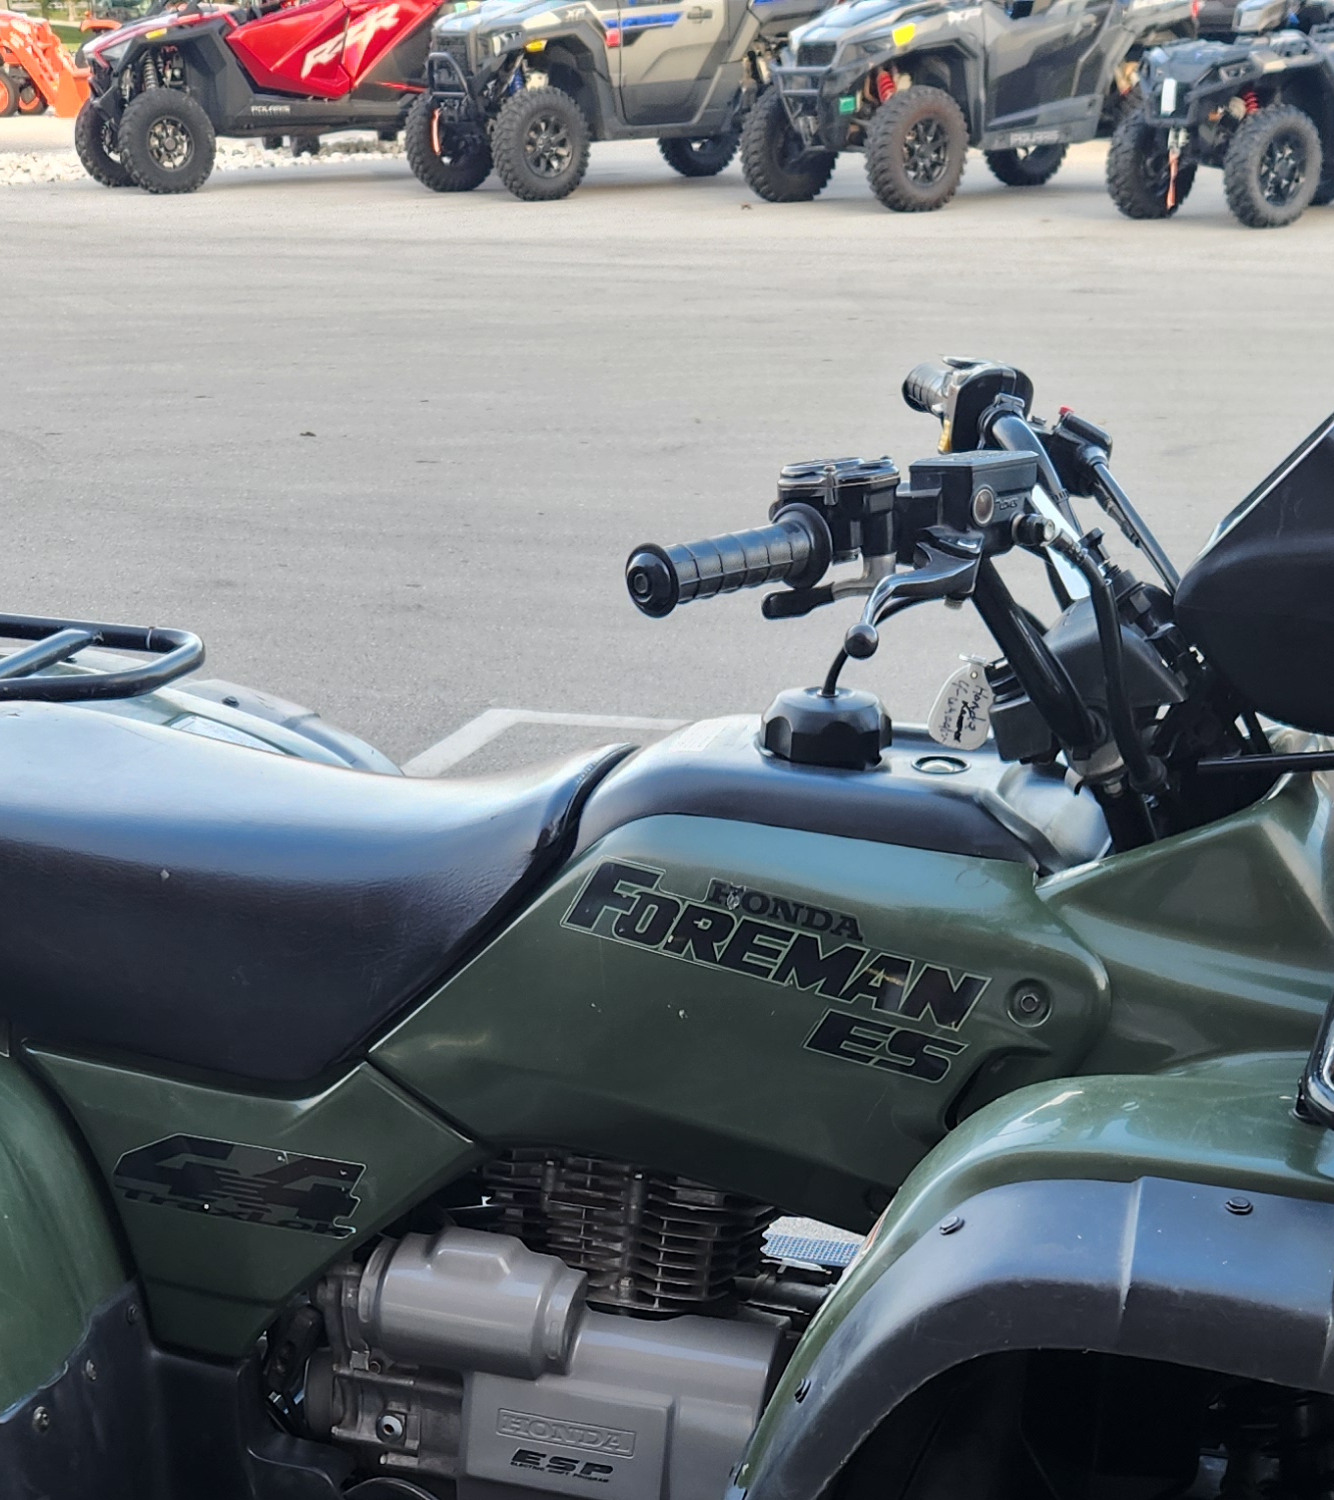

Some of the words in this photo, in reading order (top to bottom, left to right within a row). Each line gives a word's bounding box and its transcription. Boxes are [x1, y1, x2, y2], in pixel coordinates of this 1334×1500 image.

[803, 1009, 969, 1083] ES
[502, 1414, 631, 1453] HONDA
[511, 1448, 614, 1476] ESP
